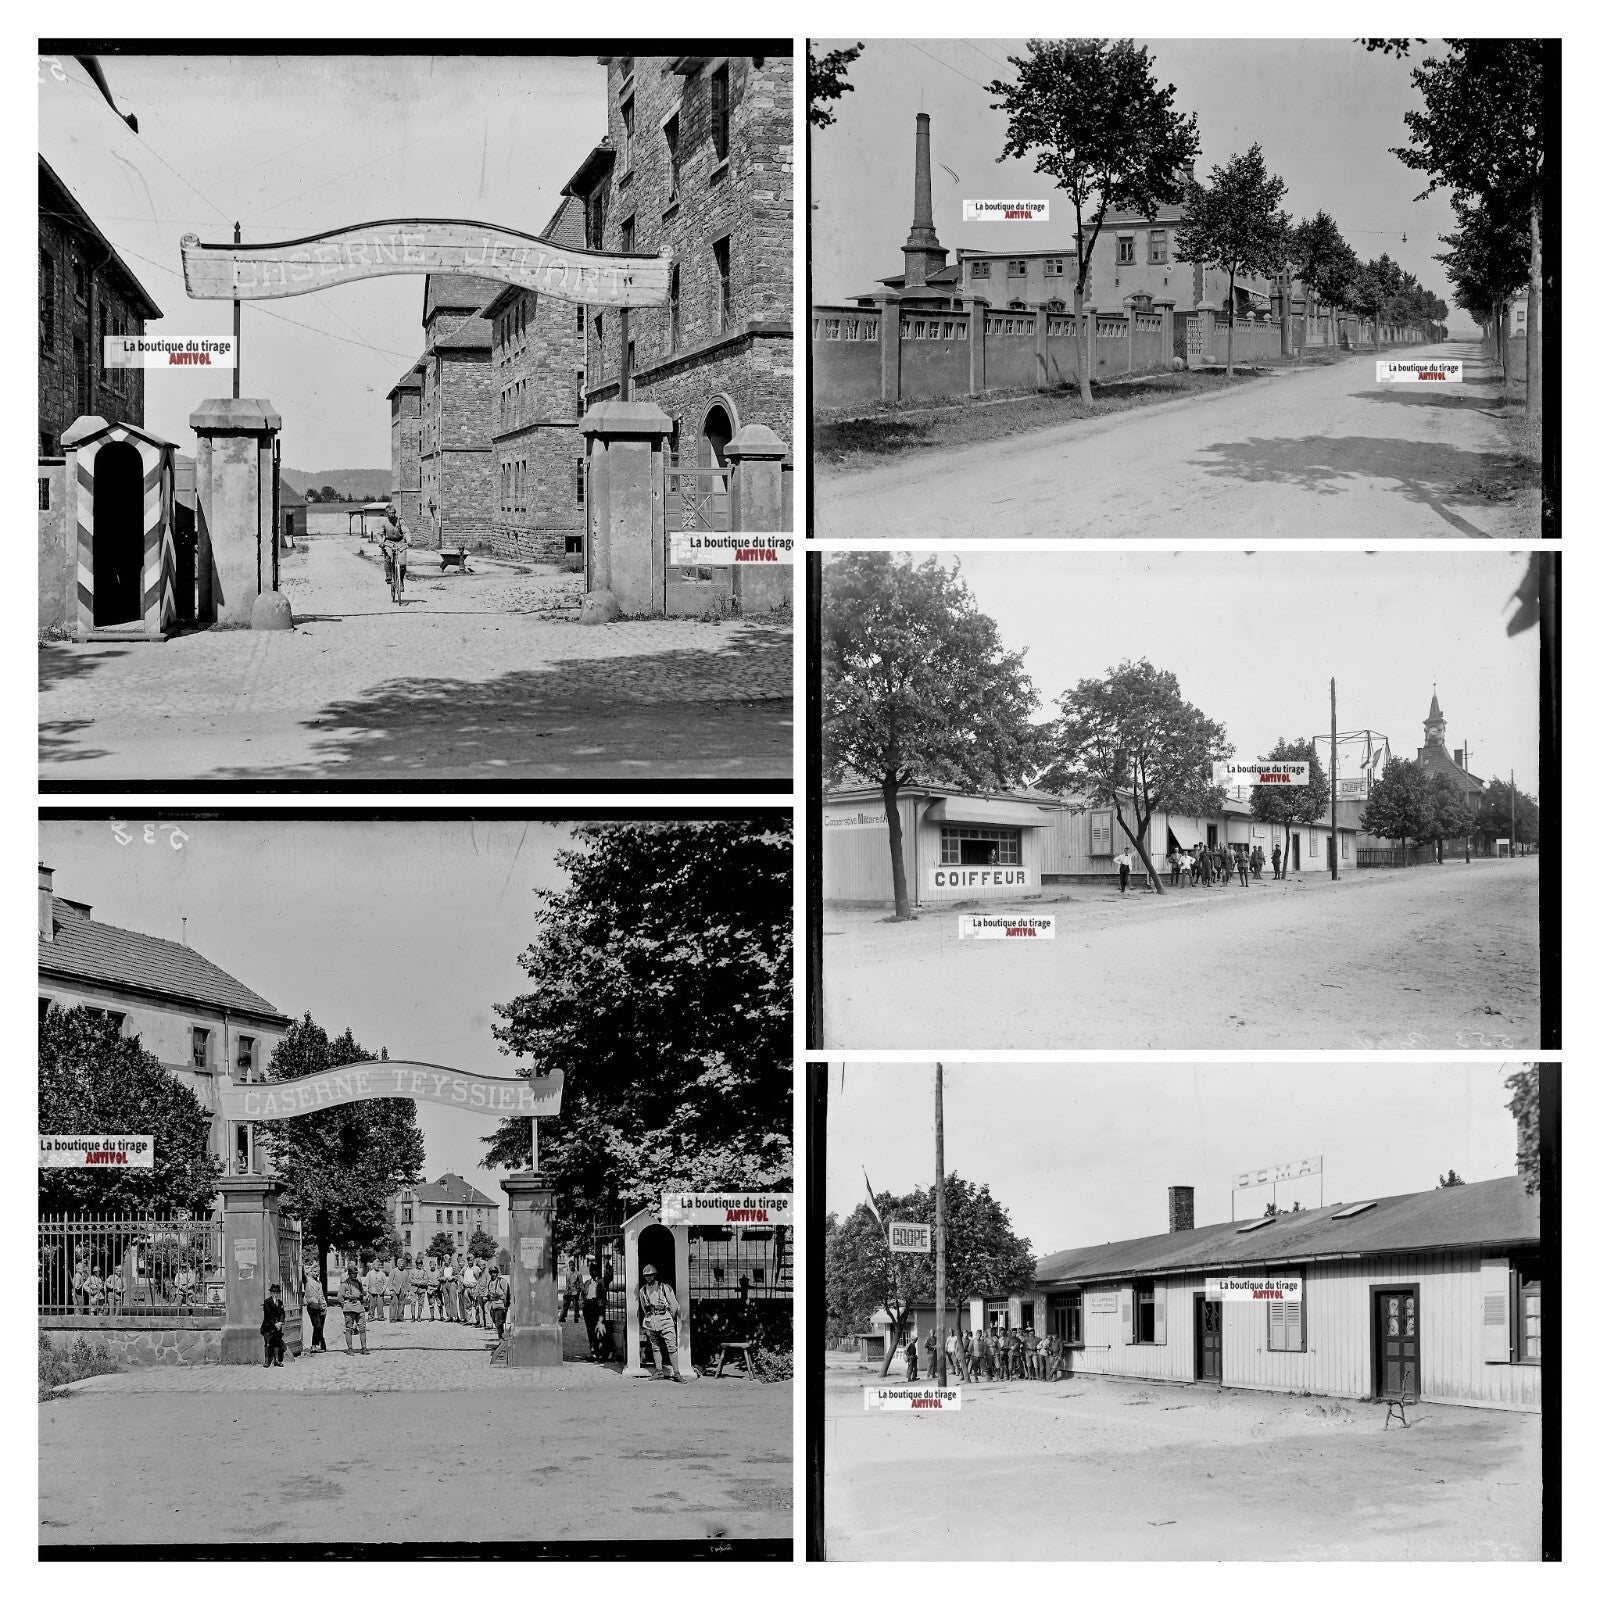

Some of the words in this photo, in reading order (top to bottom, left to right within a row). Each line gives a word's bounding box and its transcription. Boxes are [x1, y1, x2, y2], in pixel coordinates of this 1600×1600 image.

[233, 233, 426, 288] CASERNE
[935, 871, 1025, 887] COIFFEUR
[244, 1072, 372, 1115] CASERNE
[392, 1069, 538, 1111] TEYSSIER
